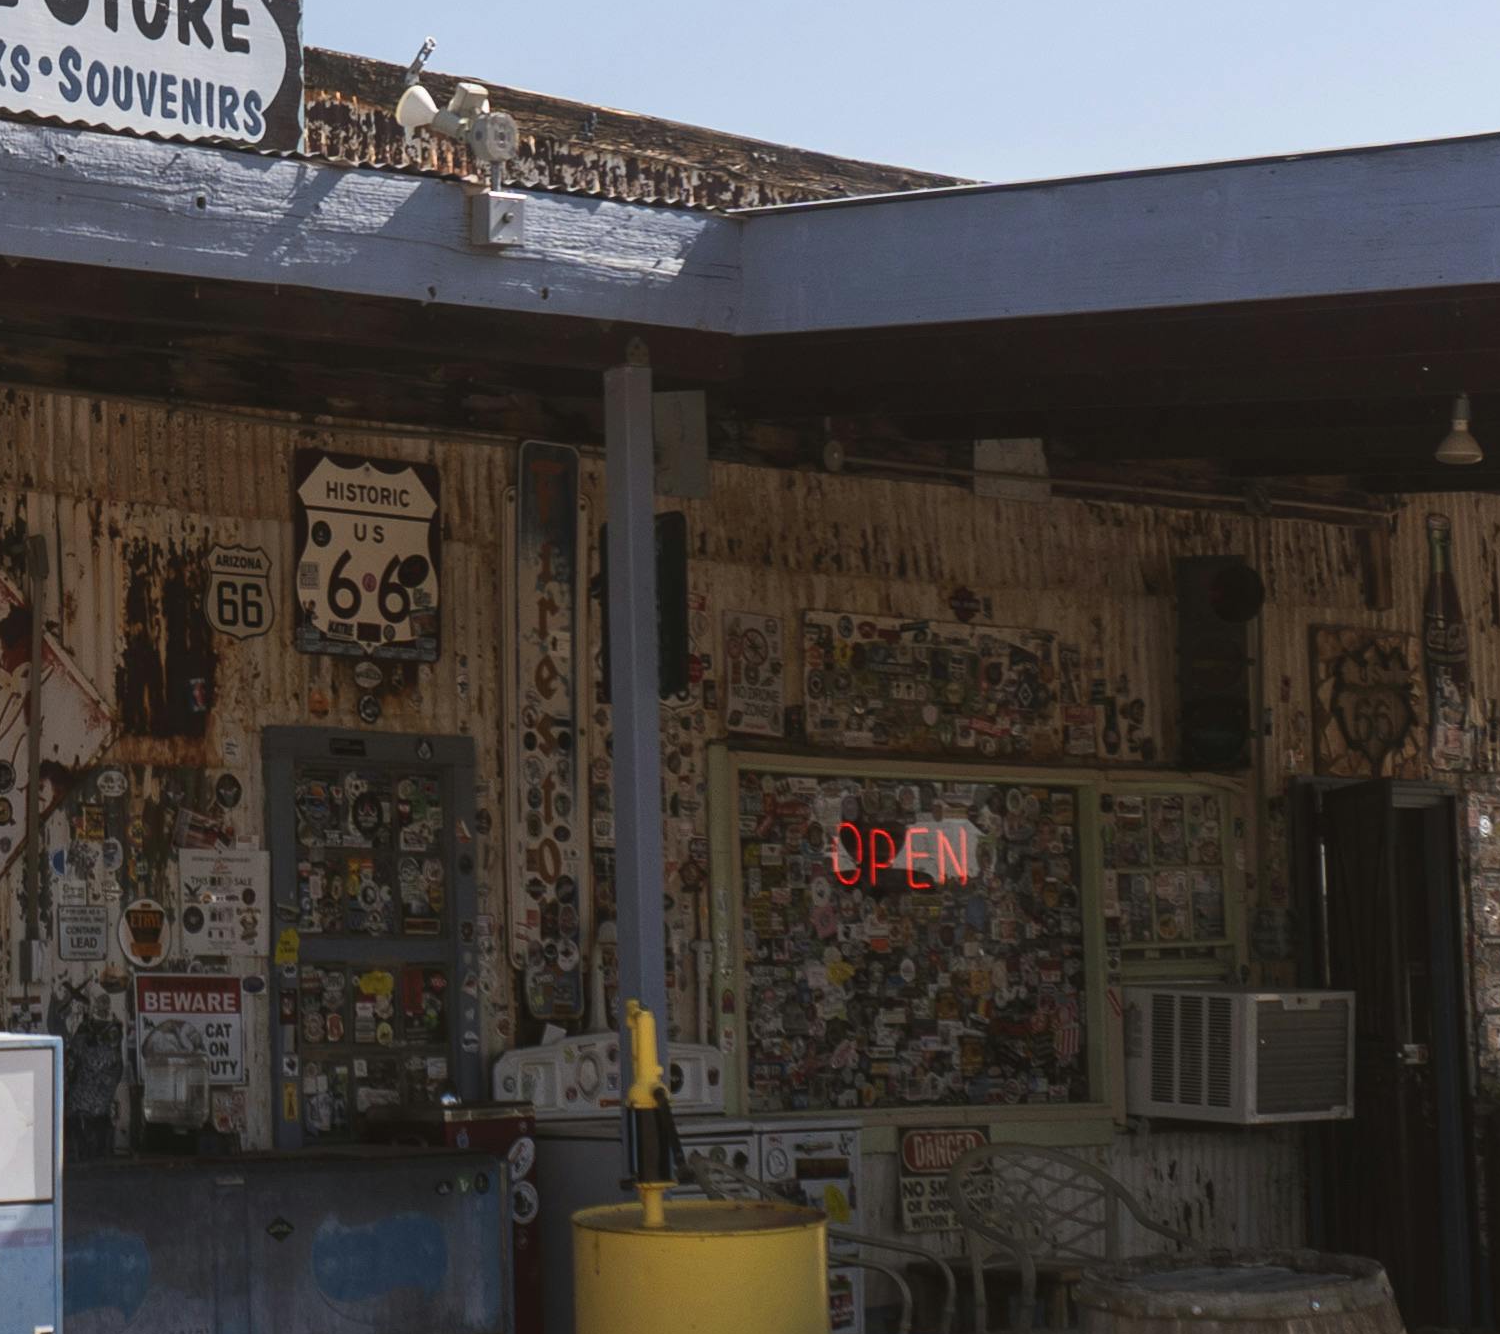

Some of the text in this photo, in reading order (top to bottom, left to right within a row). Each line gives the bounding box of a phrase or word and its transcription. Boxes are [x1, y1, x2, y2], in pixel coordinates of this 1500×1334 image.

[58, 46, 264, 137] SOUVENIRS
[326, 481, 410, 507] HISTORIC
[215, 554, 262, 570] ARIZONA
[327, 549, 411, 624] 66
[217, 581, 263, 628] 66
[832, 822, 968, 889] OPEN
[70, 937, 98, 949] LEAD
[144, 992, 237, 1012] BEWARE
[205, 1023, 232, 1039] CAT
[209, 1043, 229, 1056] ON
[210, 1061, 238, 1075] UTY
[902, 1181, 924, 1199] NO
